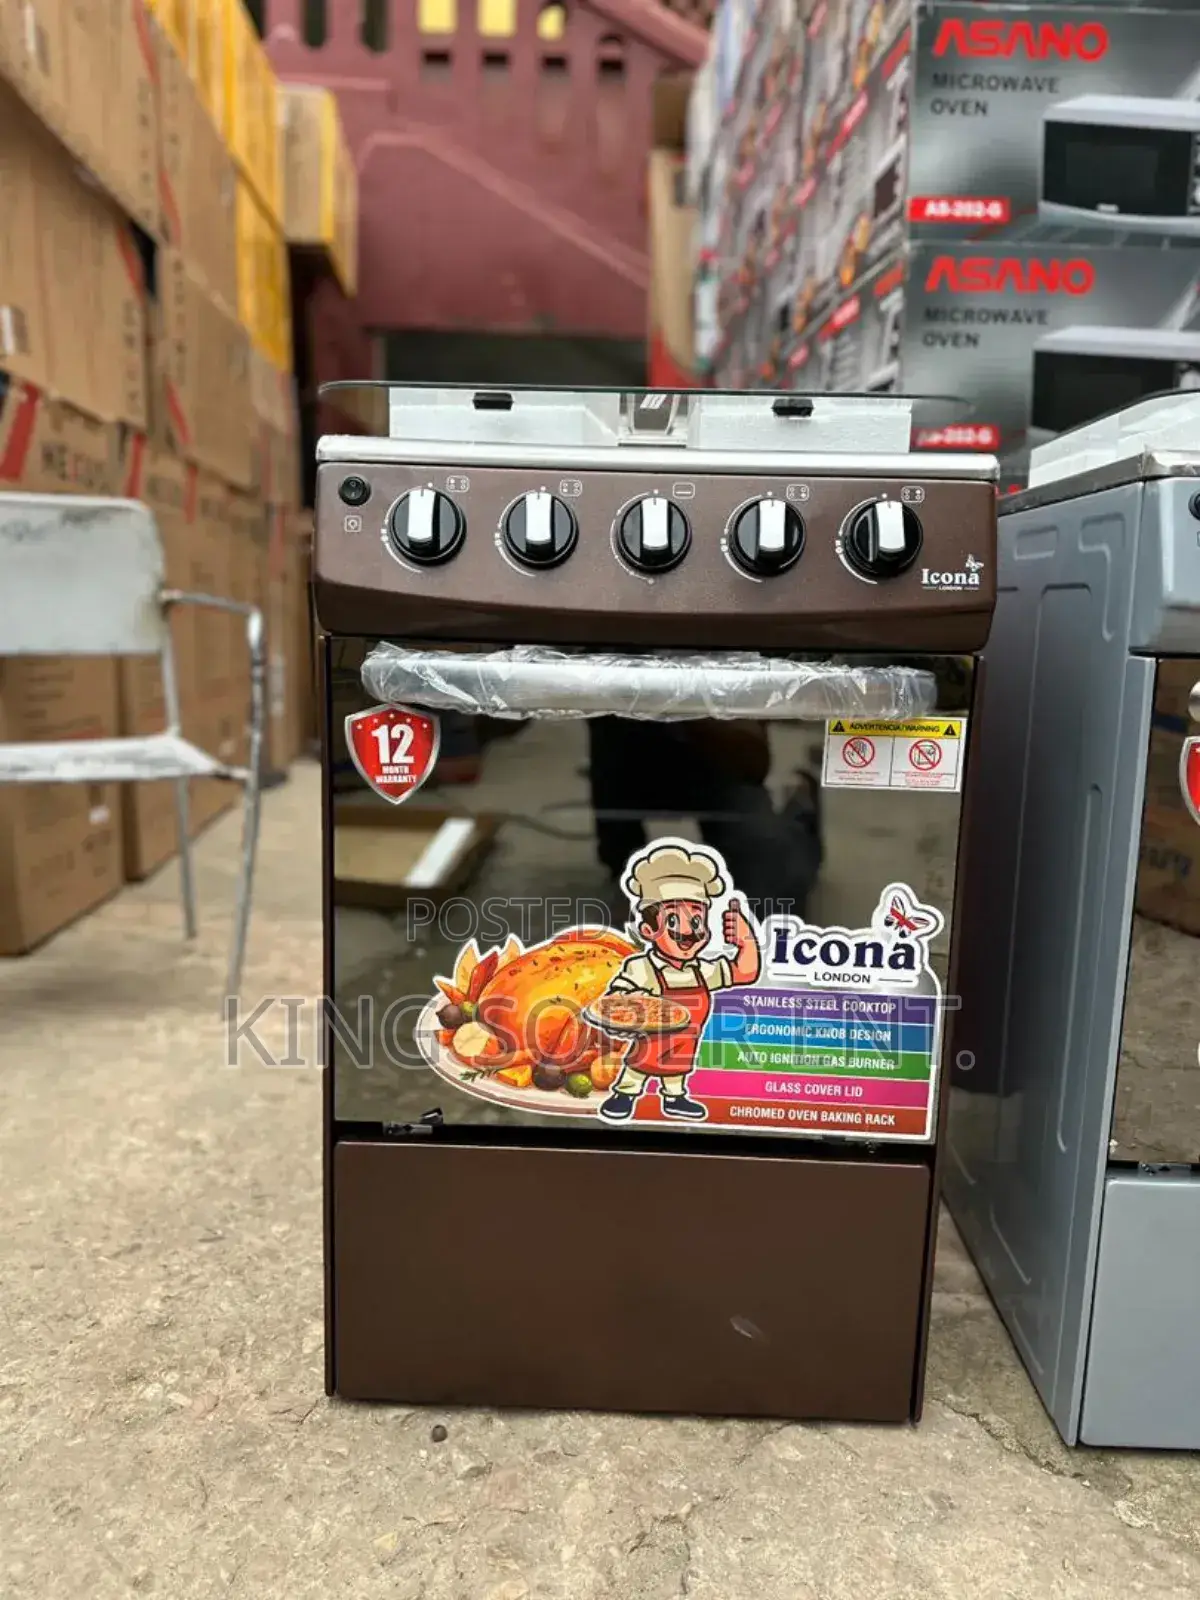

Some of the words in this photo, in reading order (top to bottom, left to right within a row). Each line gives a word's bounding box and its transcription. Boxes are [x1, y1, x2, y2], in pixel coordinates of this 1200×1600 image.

[933, 17, 1110, 62] ASANO
[931, 72, 1060, 94] MICROWAVE
[930, 98, 988, 116] OVEN
[925, 255, 1096, 296] ASANO
[924, 307, 1050, 326] MICROWAVE
[922, 331, 981, 349] OVEN
[921, 568, 979, 585] Icona
[371, 723, 415, 764] 12
[375, 774, 416, 783] WARRANTY
[382, 765, 410, 774] MONTH
[772, 928, 916, 970] Icona
[814, 971, 871, 984] LONDON
[743, 995, 802, 1010] STAINLESS
[806, 998, 839, 1012] STEEL
[842, 1000, 896, 1014] COOKTOP
[745, 1023, 812, 1038] ERGONOMIC
[815, 1026, 846, 1040] KNOB
[850, 1028, 891, 1042] DESIGN
[738, 1051, 766, 1064] AUTO
[770, 1054, 819, 1067] IGNITION
[823, 1056, 846, 1069] GAS
[849, 1057, 895, 1071] BURNER
[765, 1080, 801, 1095] GLASS
[804, 1083, 841, 1097] COVER
[844, 1085, 864, 1098] LID
[730, 1104, 785, 1120] CHROMED
[788, 1107, 819, 1121] OVEN
[821, 1109, 862, 1125] BAKING
[865, 1111, 896, 1126] RACK
